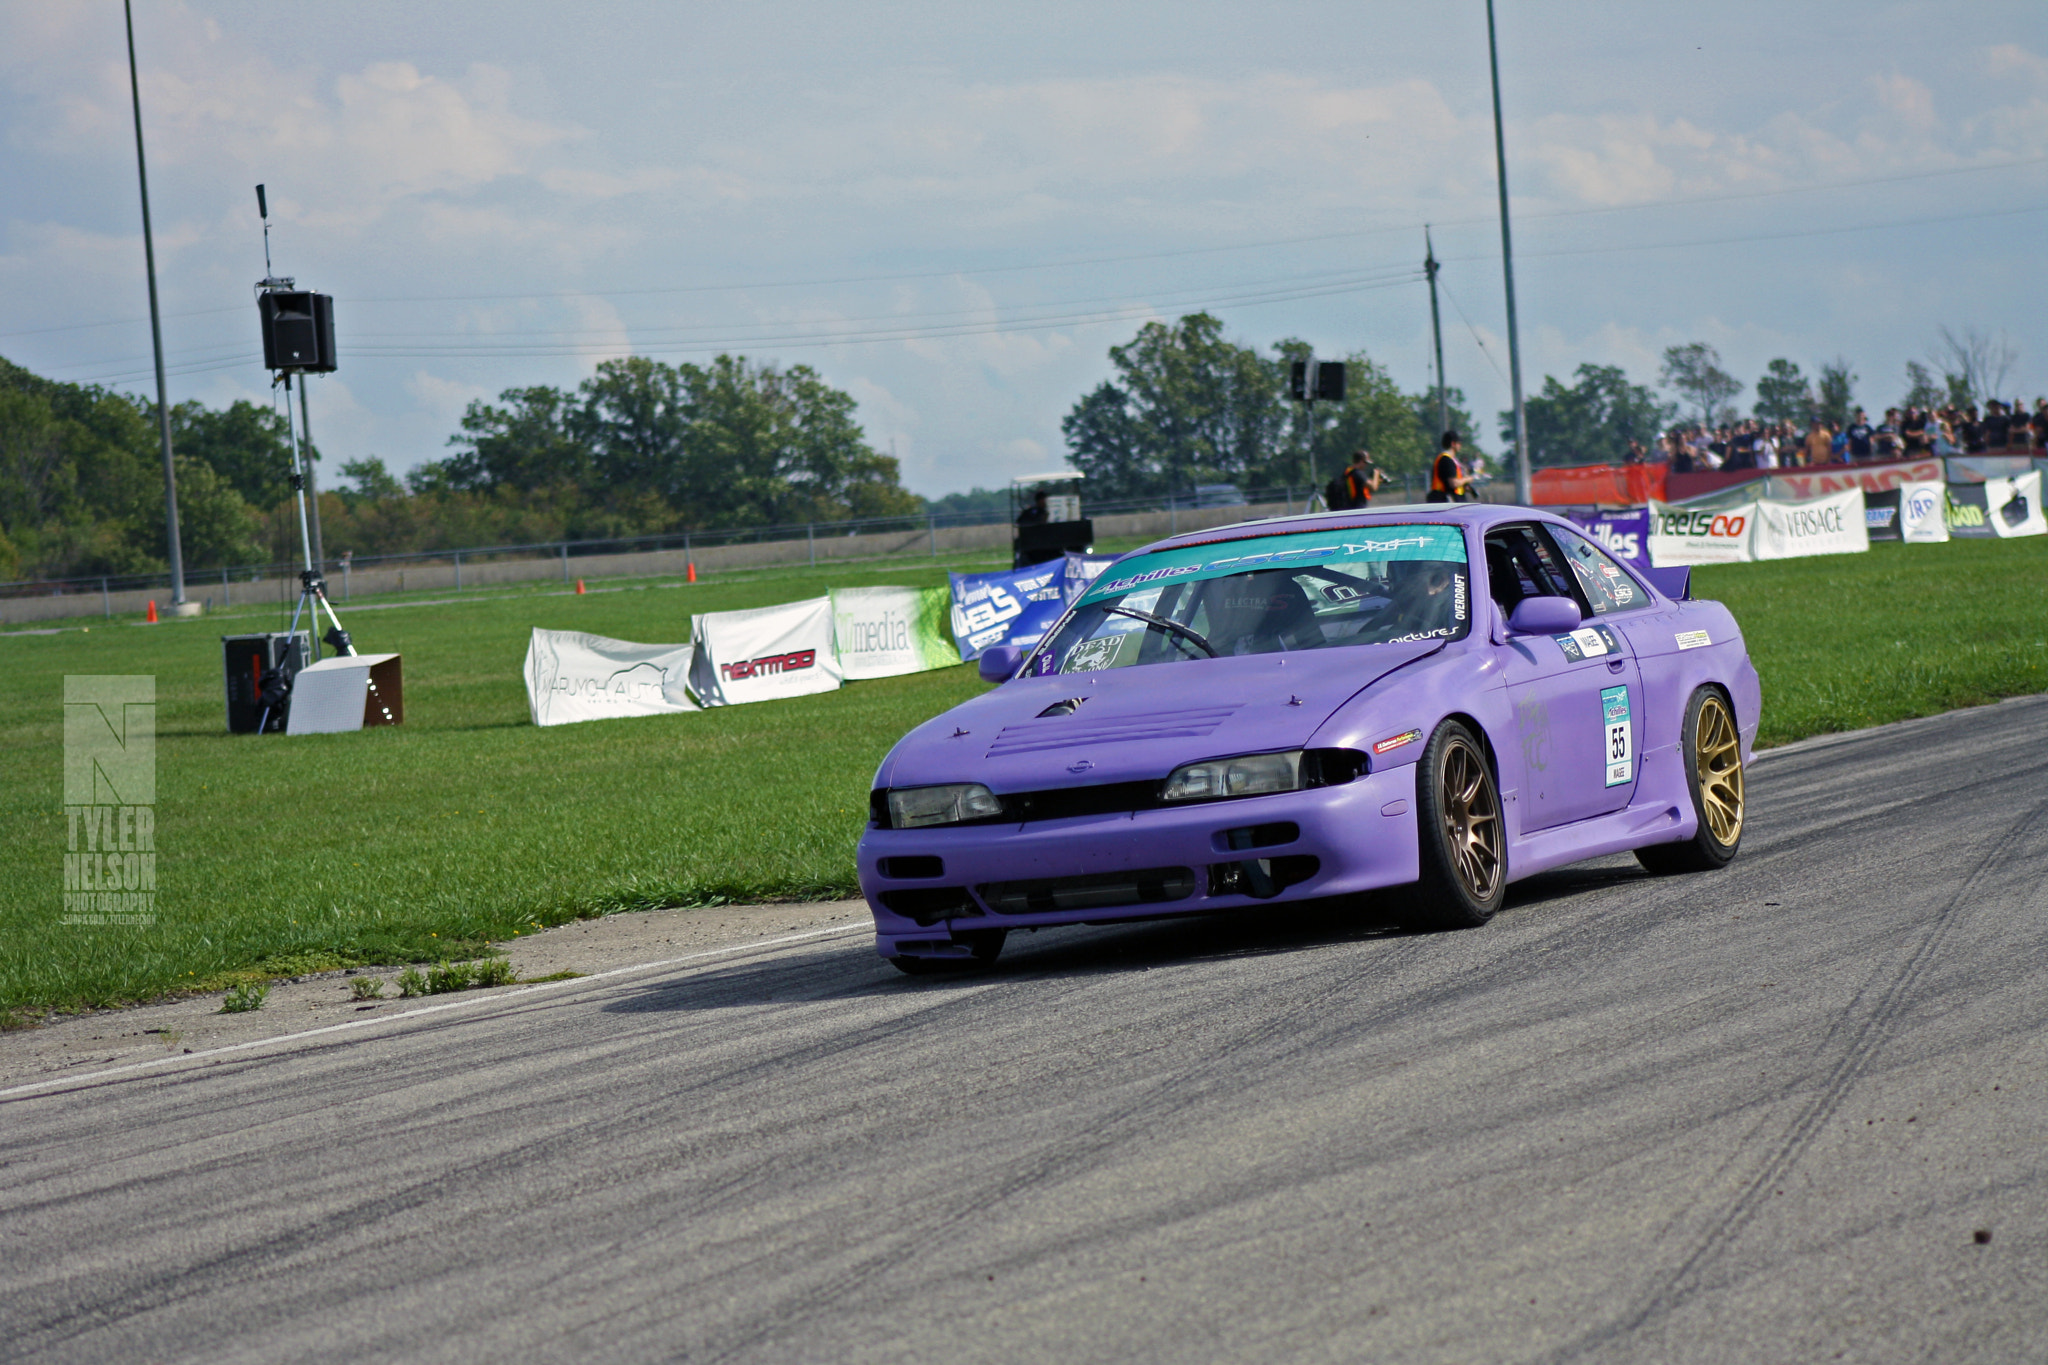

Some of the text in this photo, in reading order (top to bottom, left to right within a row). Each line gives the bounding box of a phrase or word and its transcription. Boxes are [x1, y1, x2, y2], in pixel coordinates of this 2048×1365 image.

[1785, 505, 1845, 538] VERSACE
[1585, 523, 1639, 559] lles
[1088, 564, 1202, 596] Achilles
[1454, 574, 1466, 620] OVERDRAFT
[1070, 636, 1120, 657] DEAD
[1612, 726, 1625, 760] 55
